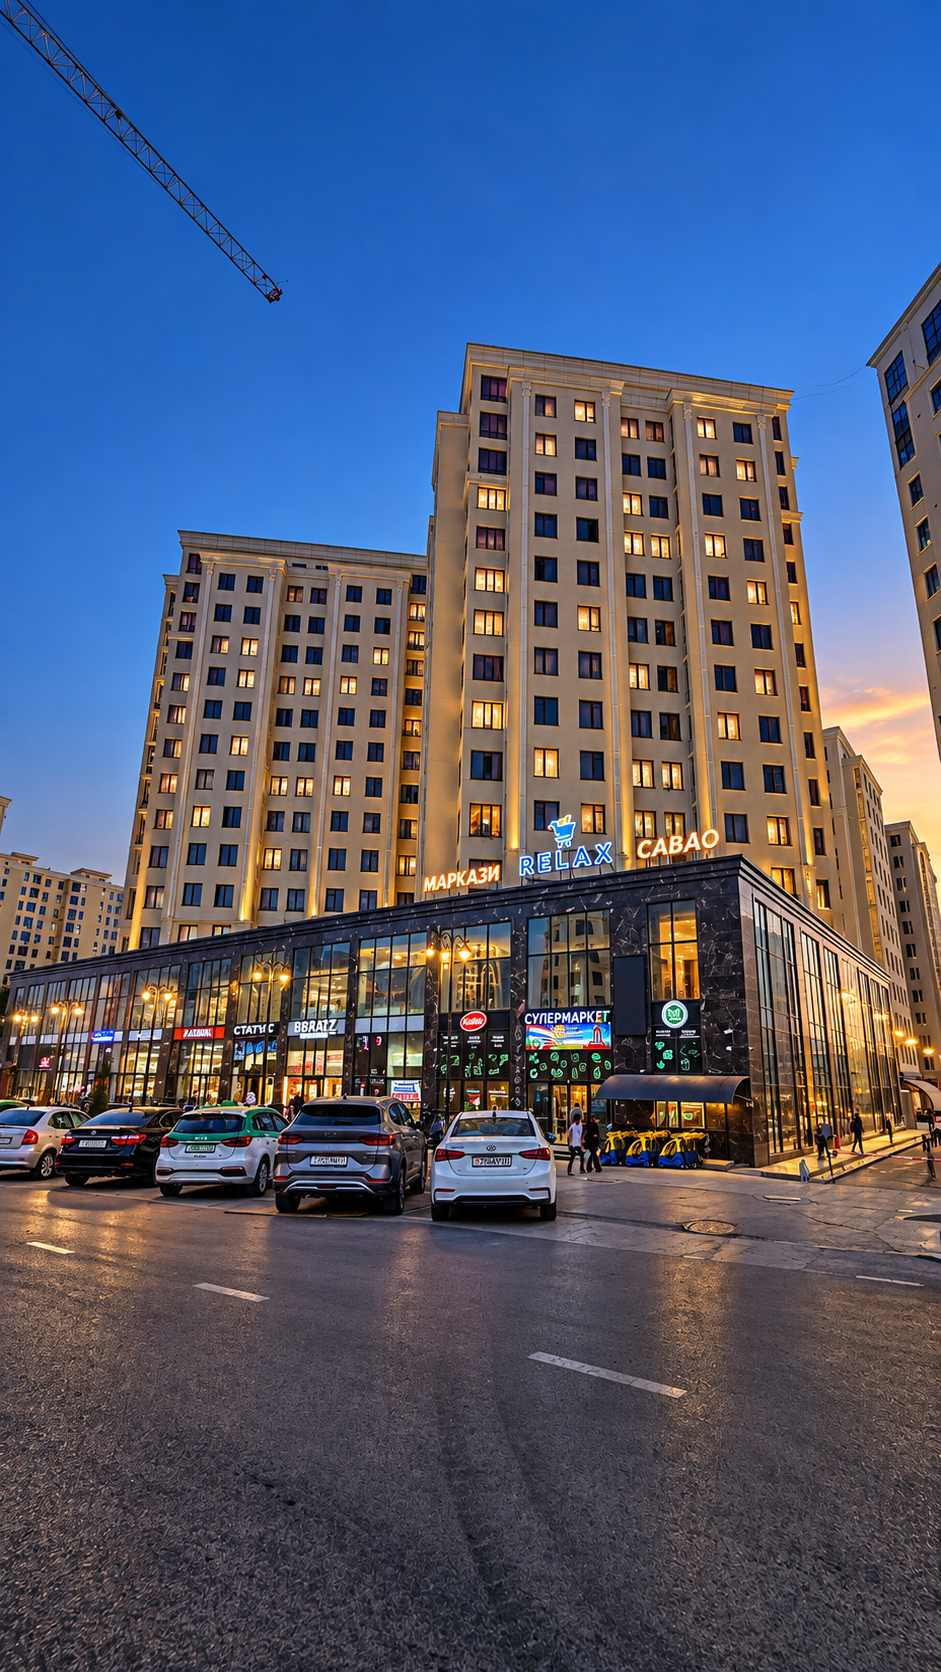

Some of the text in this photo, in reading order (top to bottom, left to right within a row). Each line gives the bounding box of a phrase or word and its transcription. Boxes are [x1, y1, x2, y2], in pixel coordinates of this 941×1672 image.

[518, 841, 614, 876] RELAX
[423, 864, 501, 892] МАРКАЗИ
[524, 1010, 611, 1025] СУПЕРМАРКЕТ
